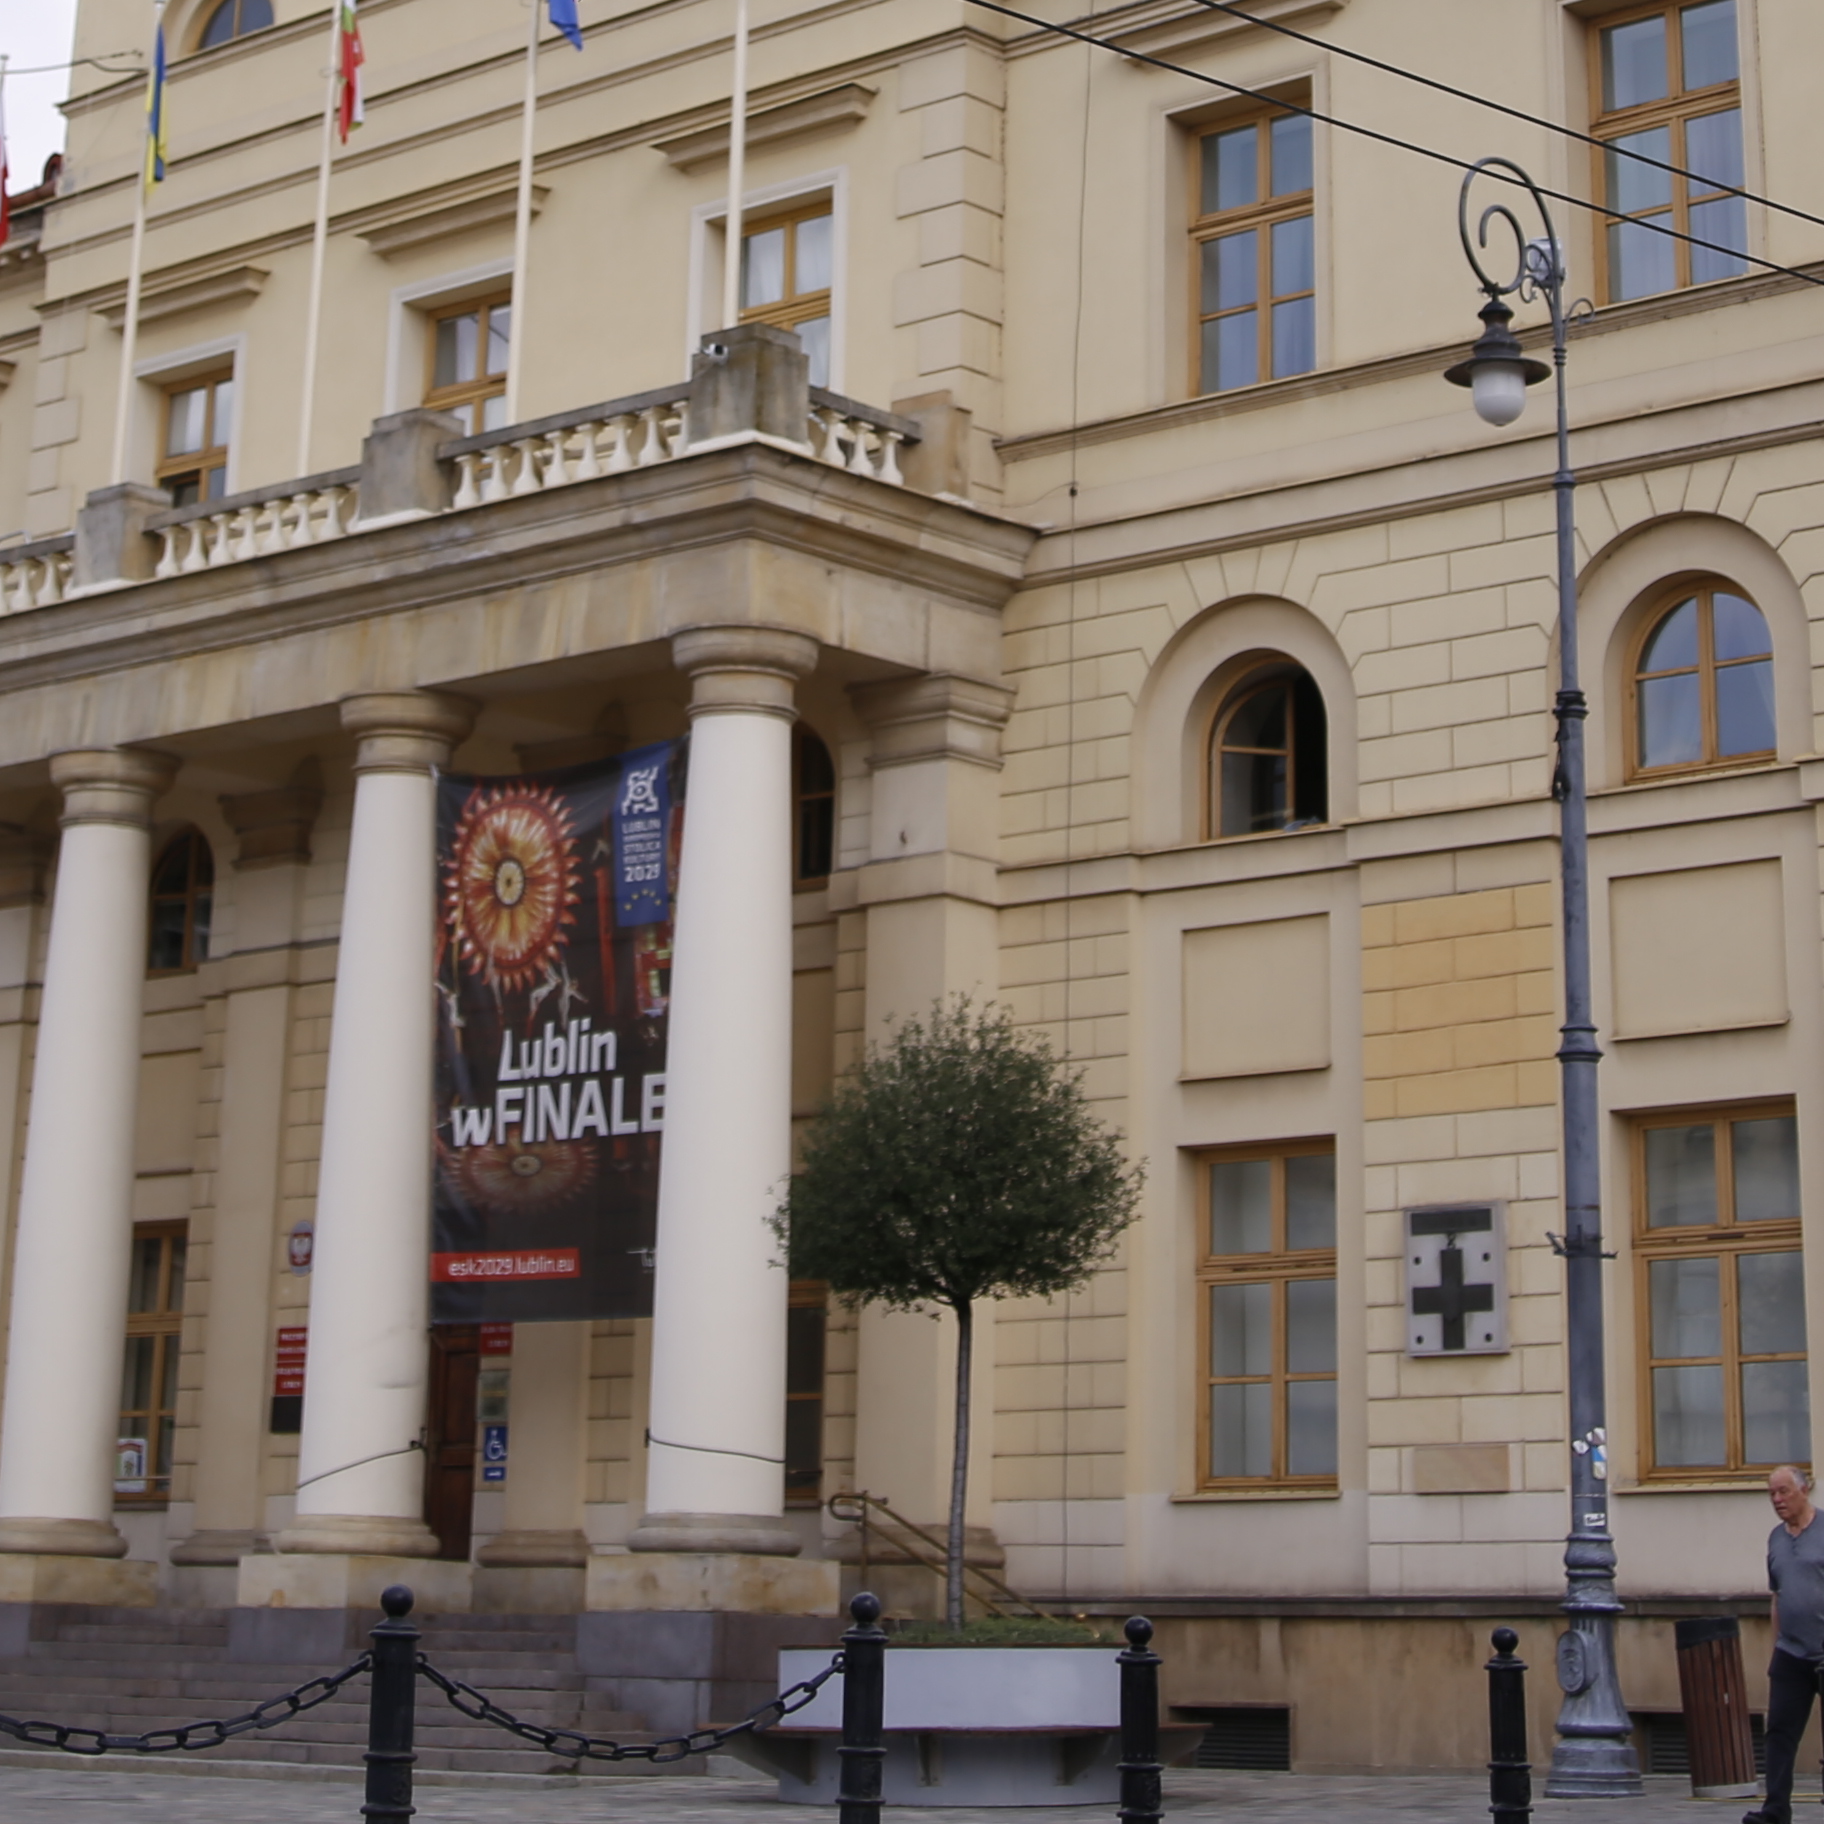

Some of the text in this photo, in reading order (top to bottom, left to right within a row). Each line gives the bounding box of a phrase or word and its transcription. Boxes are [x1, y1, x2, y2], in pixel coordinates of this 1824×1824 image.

[624, 863, 661, 882] 2029
[497, 1017, 617, 1081] Lublin
[448, 1255, 575, 1276] esk2029.lublin.eu
